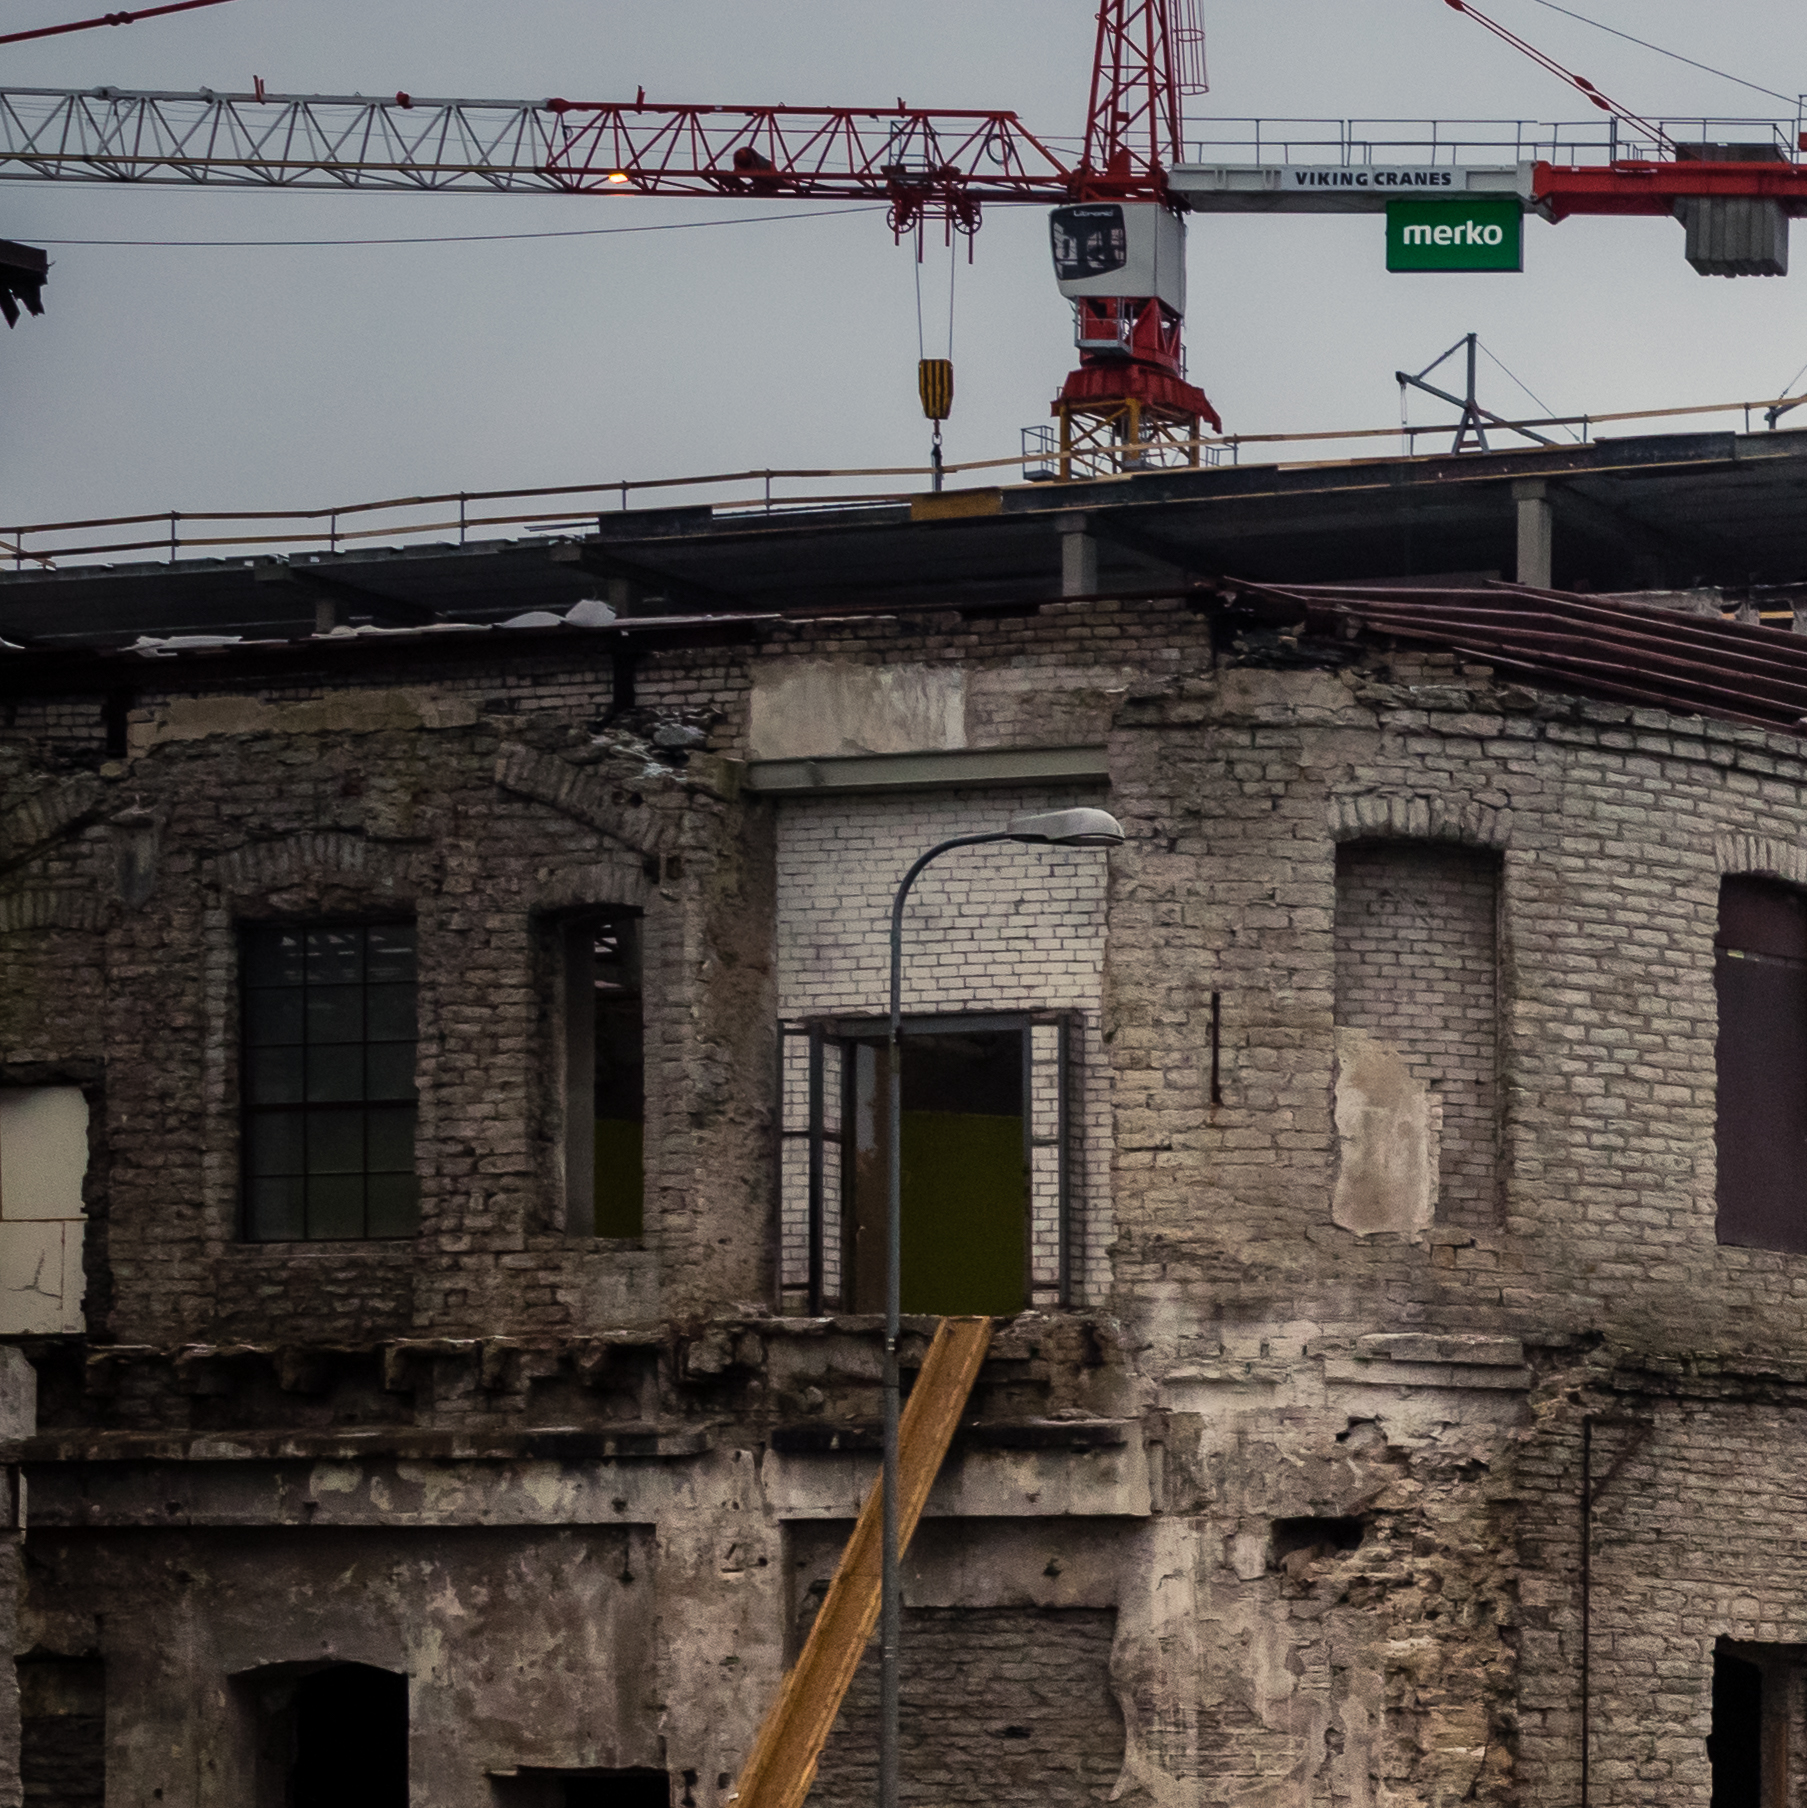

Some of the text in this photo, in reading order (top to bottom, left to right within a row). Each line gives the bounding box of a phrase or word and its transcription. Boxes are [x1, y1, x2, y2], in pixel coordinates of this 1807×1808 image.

[1295, 172, 1452, 186] VIKING CRANES
[1403, 220, 1503, 245] merko
